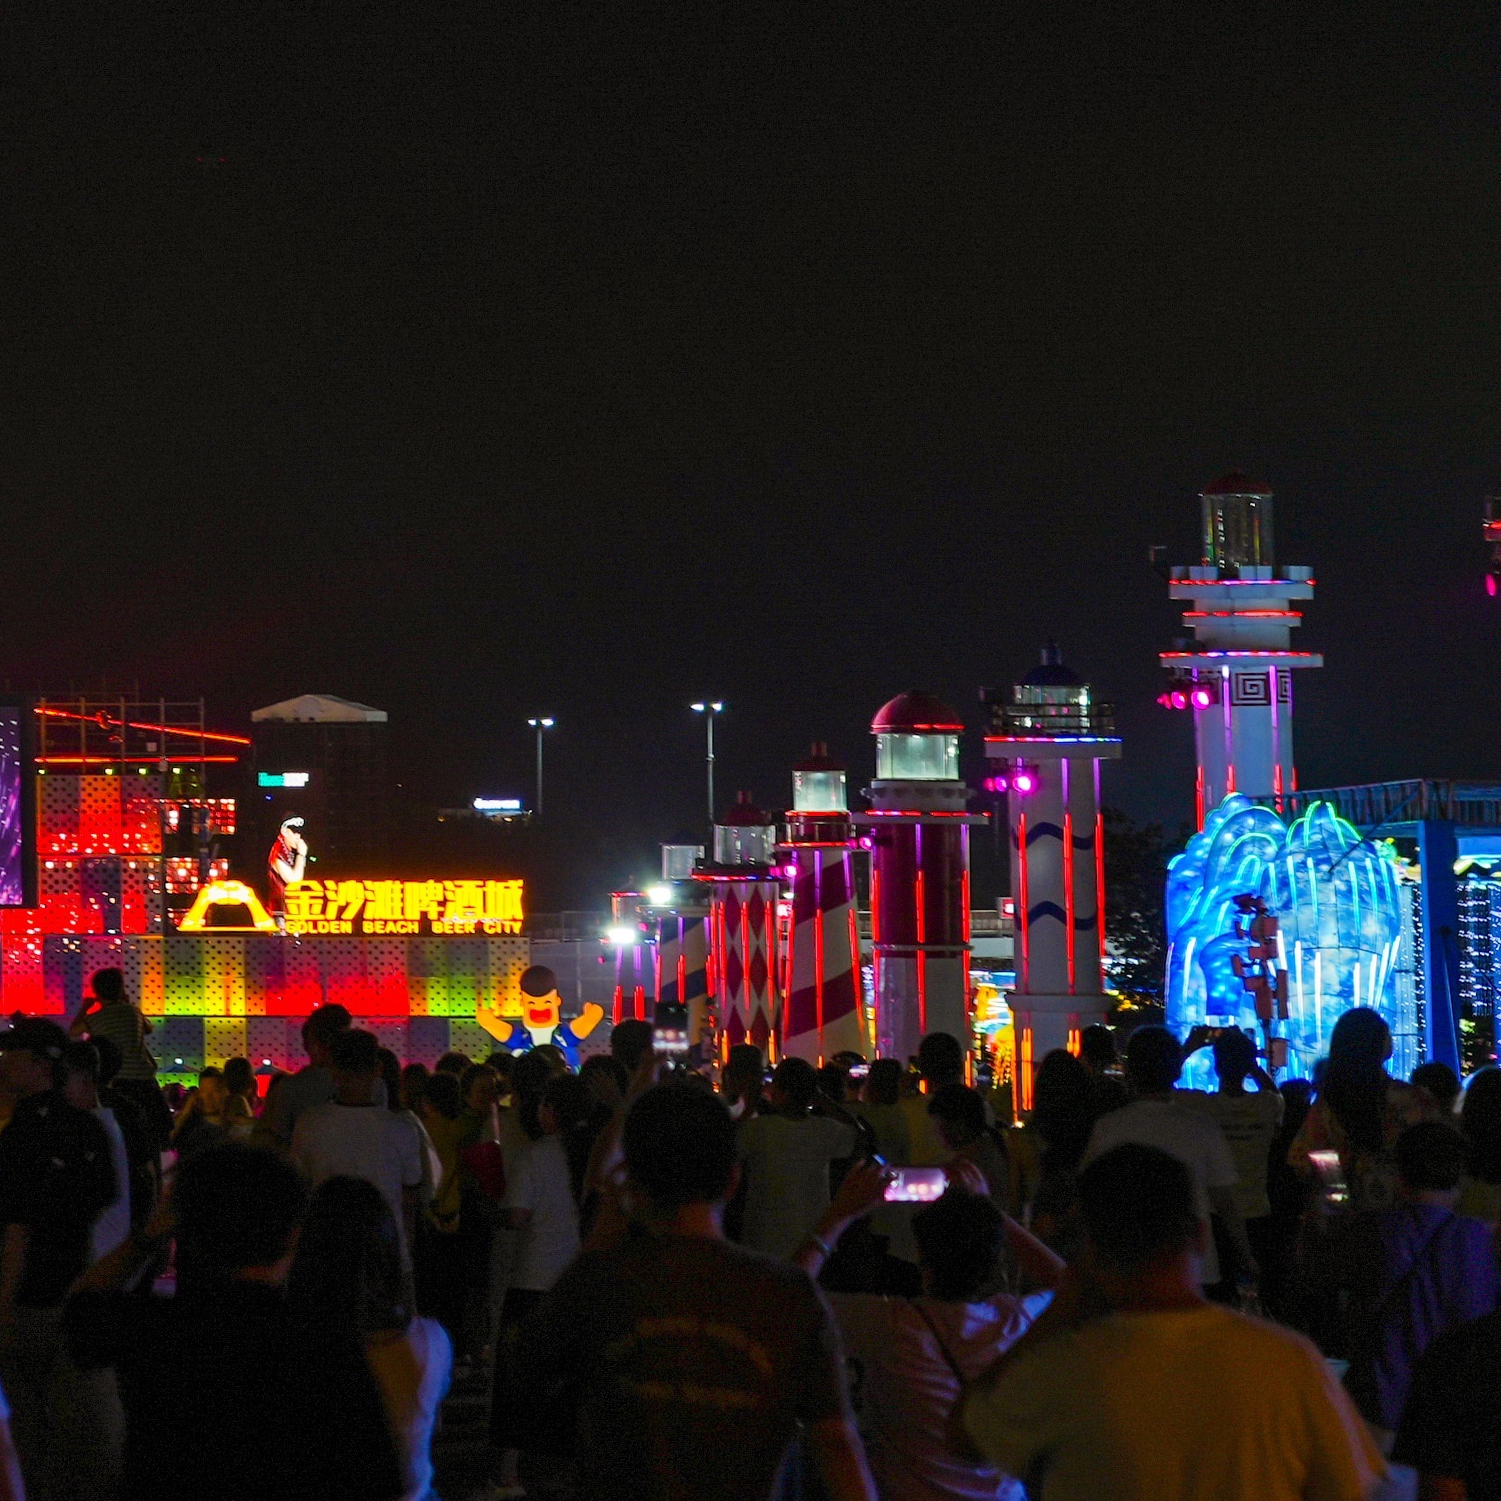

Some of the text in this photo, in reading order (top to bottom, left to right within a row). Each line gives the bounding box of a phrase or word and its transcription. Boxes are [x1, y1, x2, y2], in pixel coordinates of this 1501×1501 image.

[284, 879, 524, 921] 金沙滩啤酒城
[285, 921, 522, 934] GOLDEN BEACH BEER CITY
